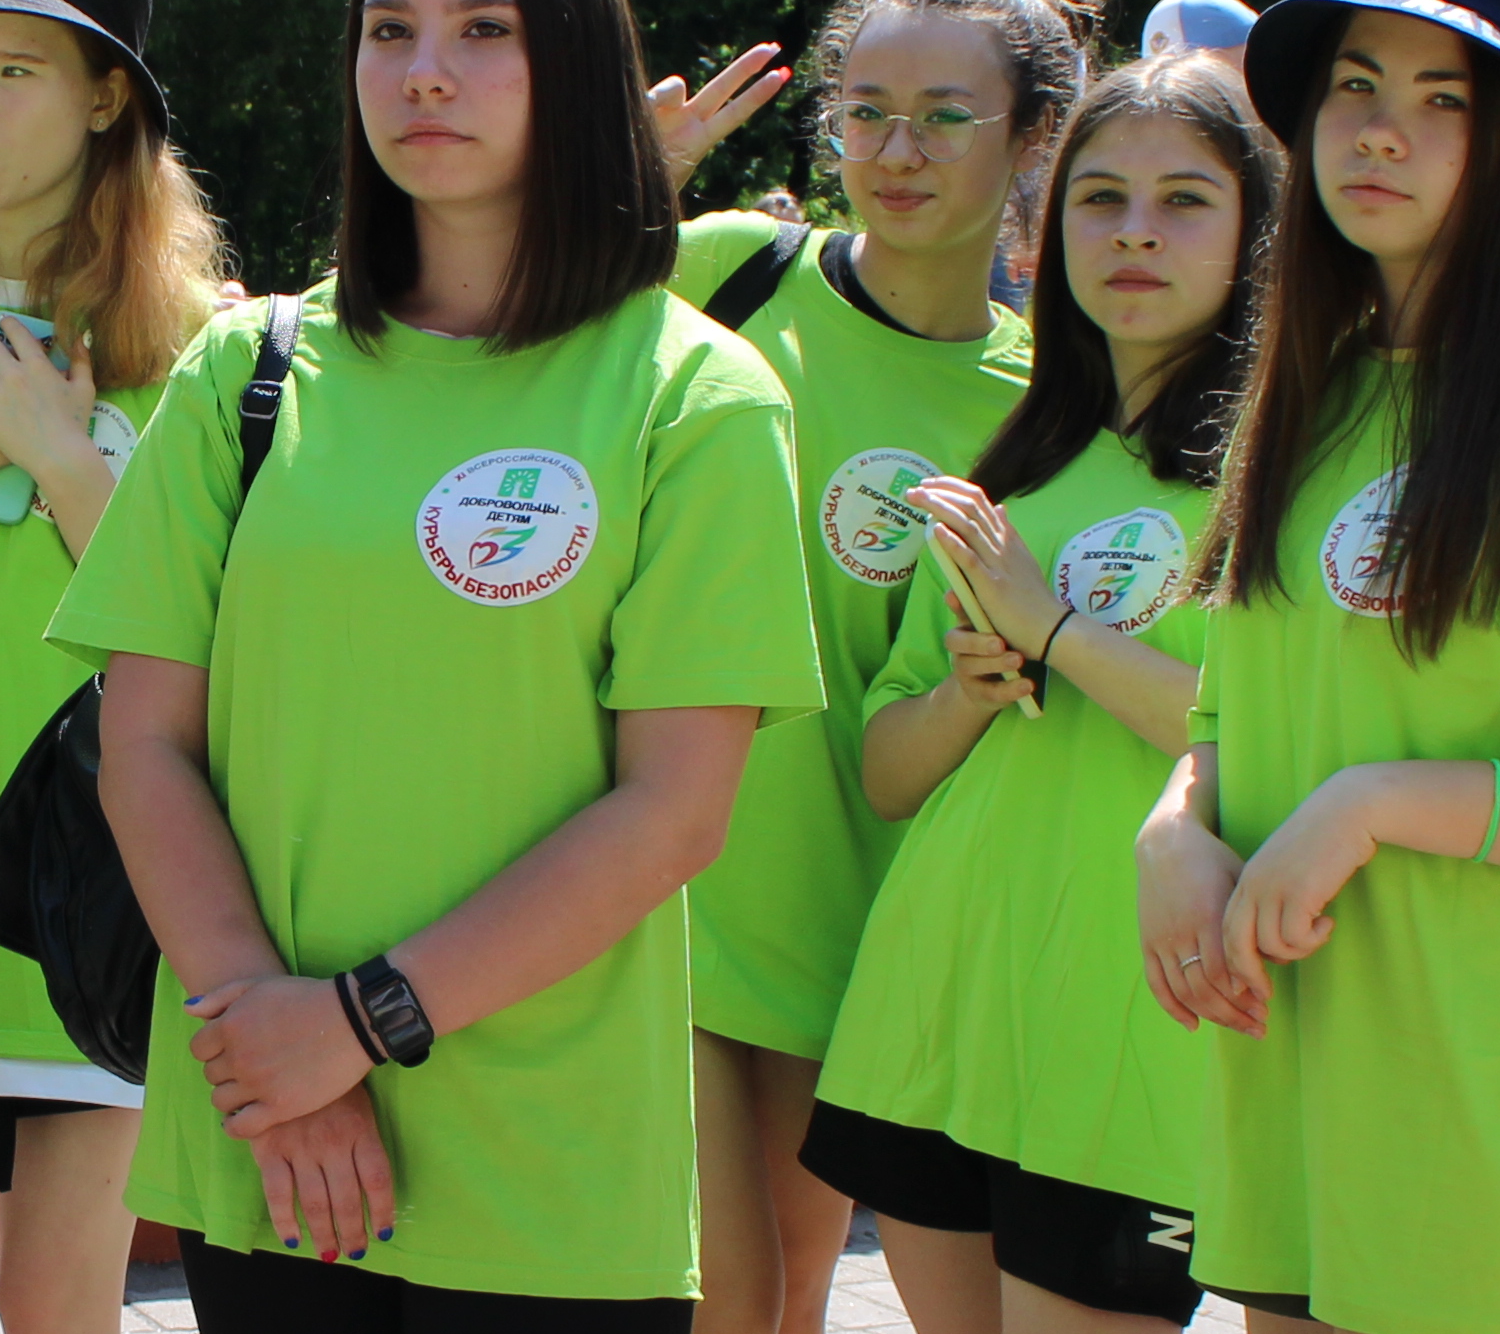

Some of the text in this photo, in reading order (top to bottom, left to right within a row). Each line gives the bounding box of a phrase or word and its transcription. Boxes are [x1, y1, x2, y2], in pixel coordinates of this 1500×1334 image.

[466, 453, 561, 475] ВСЕРОССИЙСКАЯ
[559, 463, 585, 491] АКЦИЯ
[868, 453, 936, 476] ВСЕРОССИЙСКА
[458, 496, 560, 515] ДОБРОВОЛЬЦЫ
[875, 506, 909, 528] ДЕТЯМ
[485, 511, 531, 524] ДЕТЯМ
[824, 484, 846, 556] КУРЬЕРЫ
[422, 505, 591, 600] КУРЬЕРЫ БЕЗОПАСНОСТИ
[1081, 551, 1156, 562] ДОБРОВОЛЬЦЫ
[1324, 522, 1349, 594] КУРЬЕРЫ
